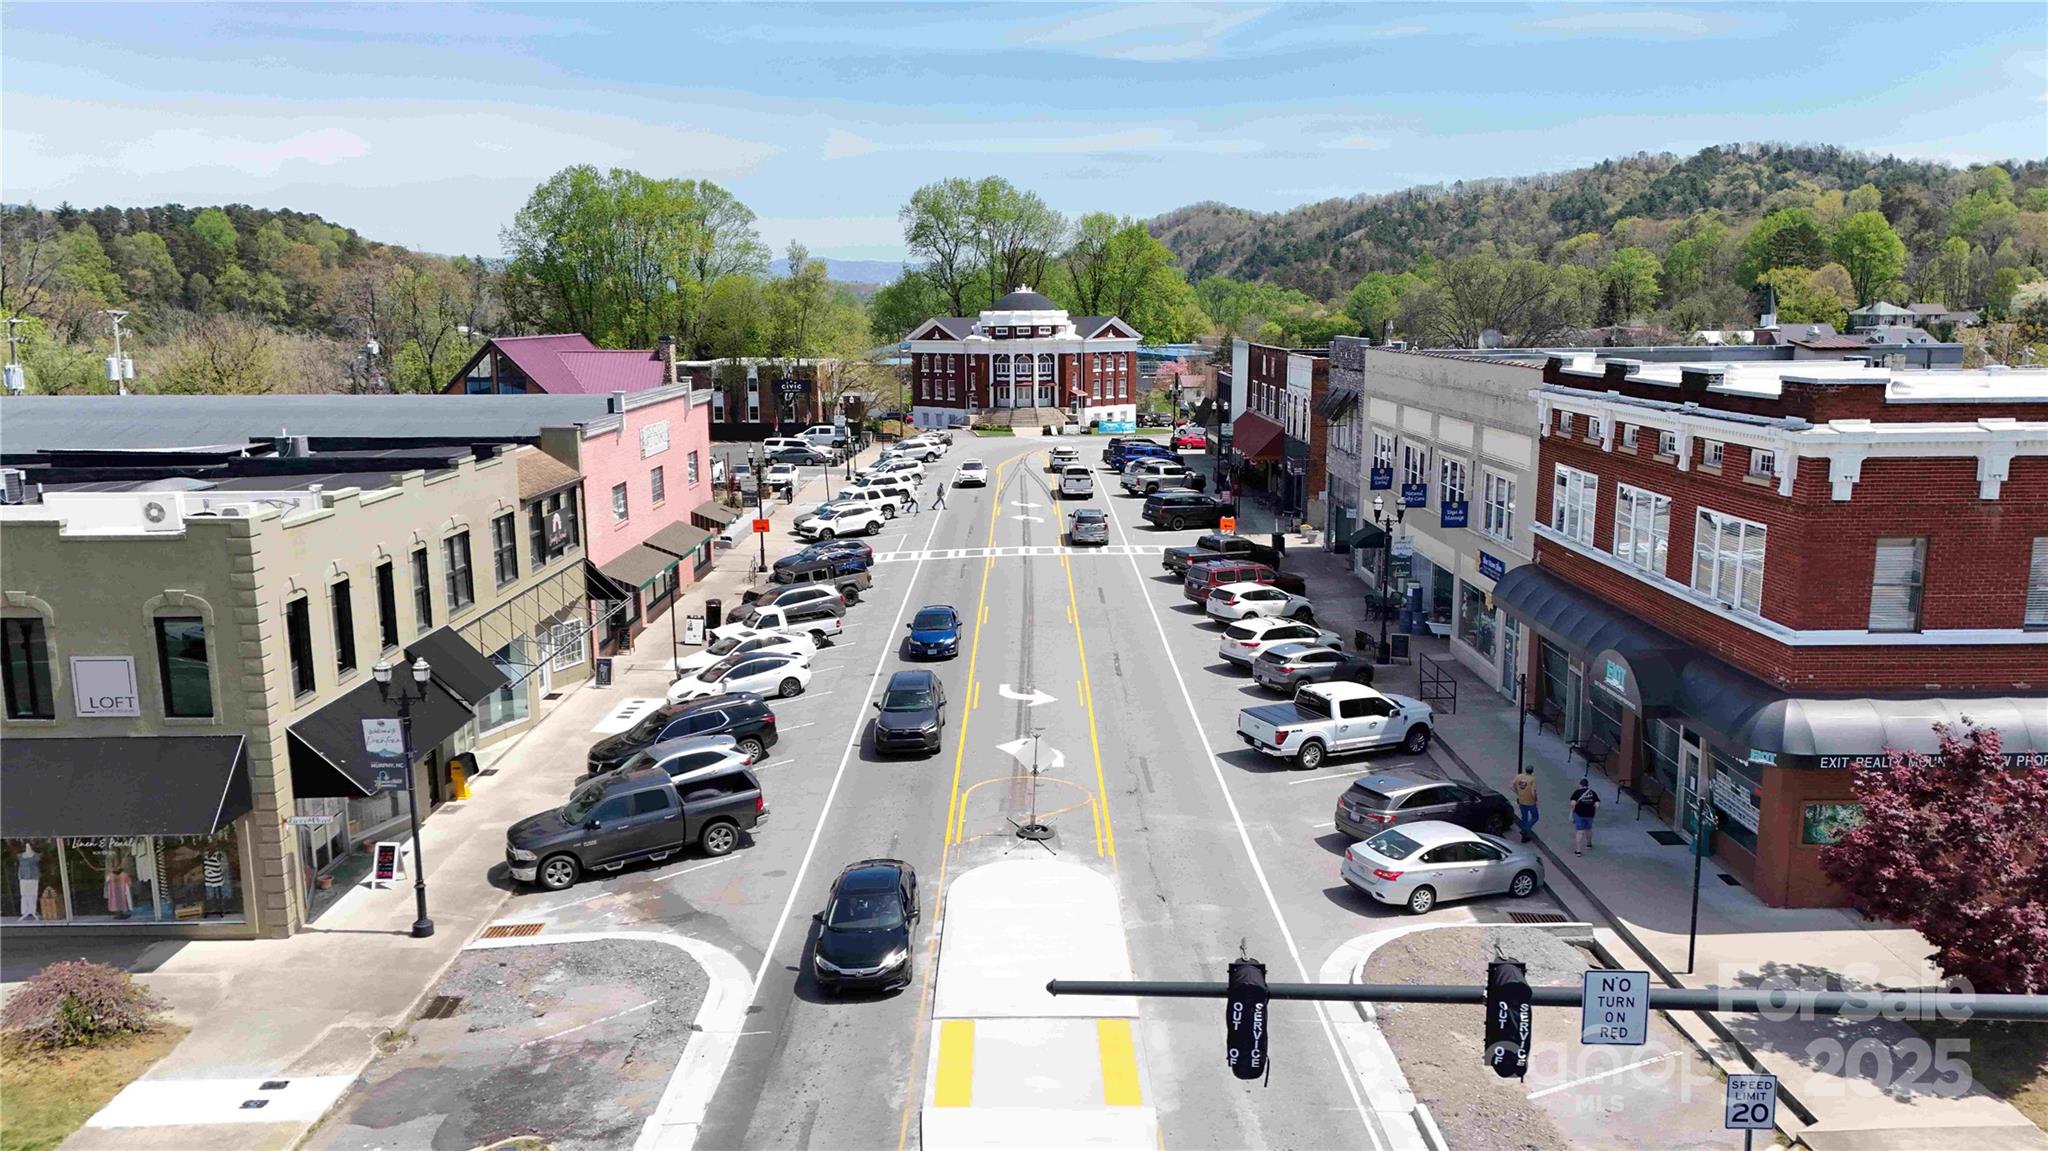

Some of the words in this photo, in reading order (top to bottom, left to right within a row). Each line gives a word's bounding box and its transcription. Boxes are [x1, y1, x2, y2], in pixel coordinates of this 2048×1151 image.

[89, 696, 135, 709] LOFT
[1820, 757, 1850, 769] EXIT
[1602, 978, 1631, 992] NO
[1598, 996, 1635, 1008] TURN
[1232, 1002, 1243, 1031] OUT
[1499, 1001, 1508, 1029] OUT
[1605, 1011, 1626, 1023] ON
[1251, 1003, 1264, 1068] SERVICE
[1517, 1003, 1530, 1067] SERVICE
[1600, 1026, 1628, 1039] RED
[1229, 1048, 1240, 1066] OF
[1494, 1046, 1505, 1065] OF
[1731, 1080, 1773, 1090] SPEED
[1735, 1091, 1767, 1101] LIMIT
[1731, 1103, 1769, 1123] 20
